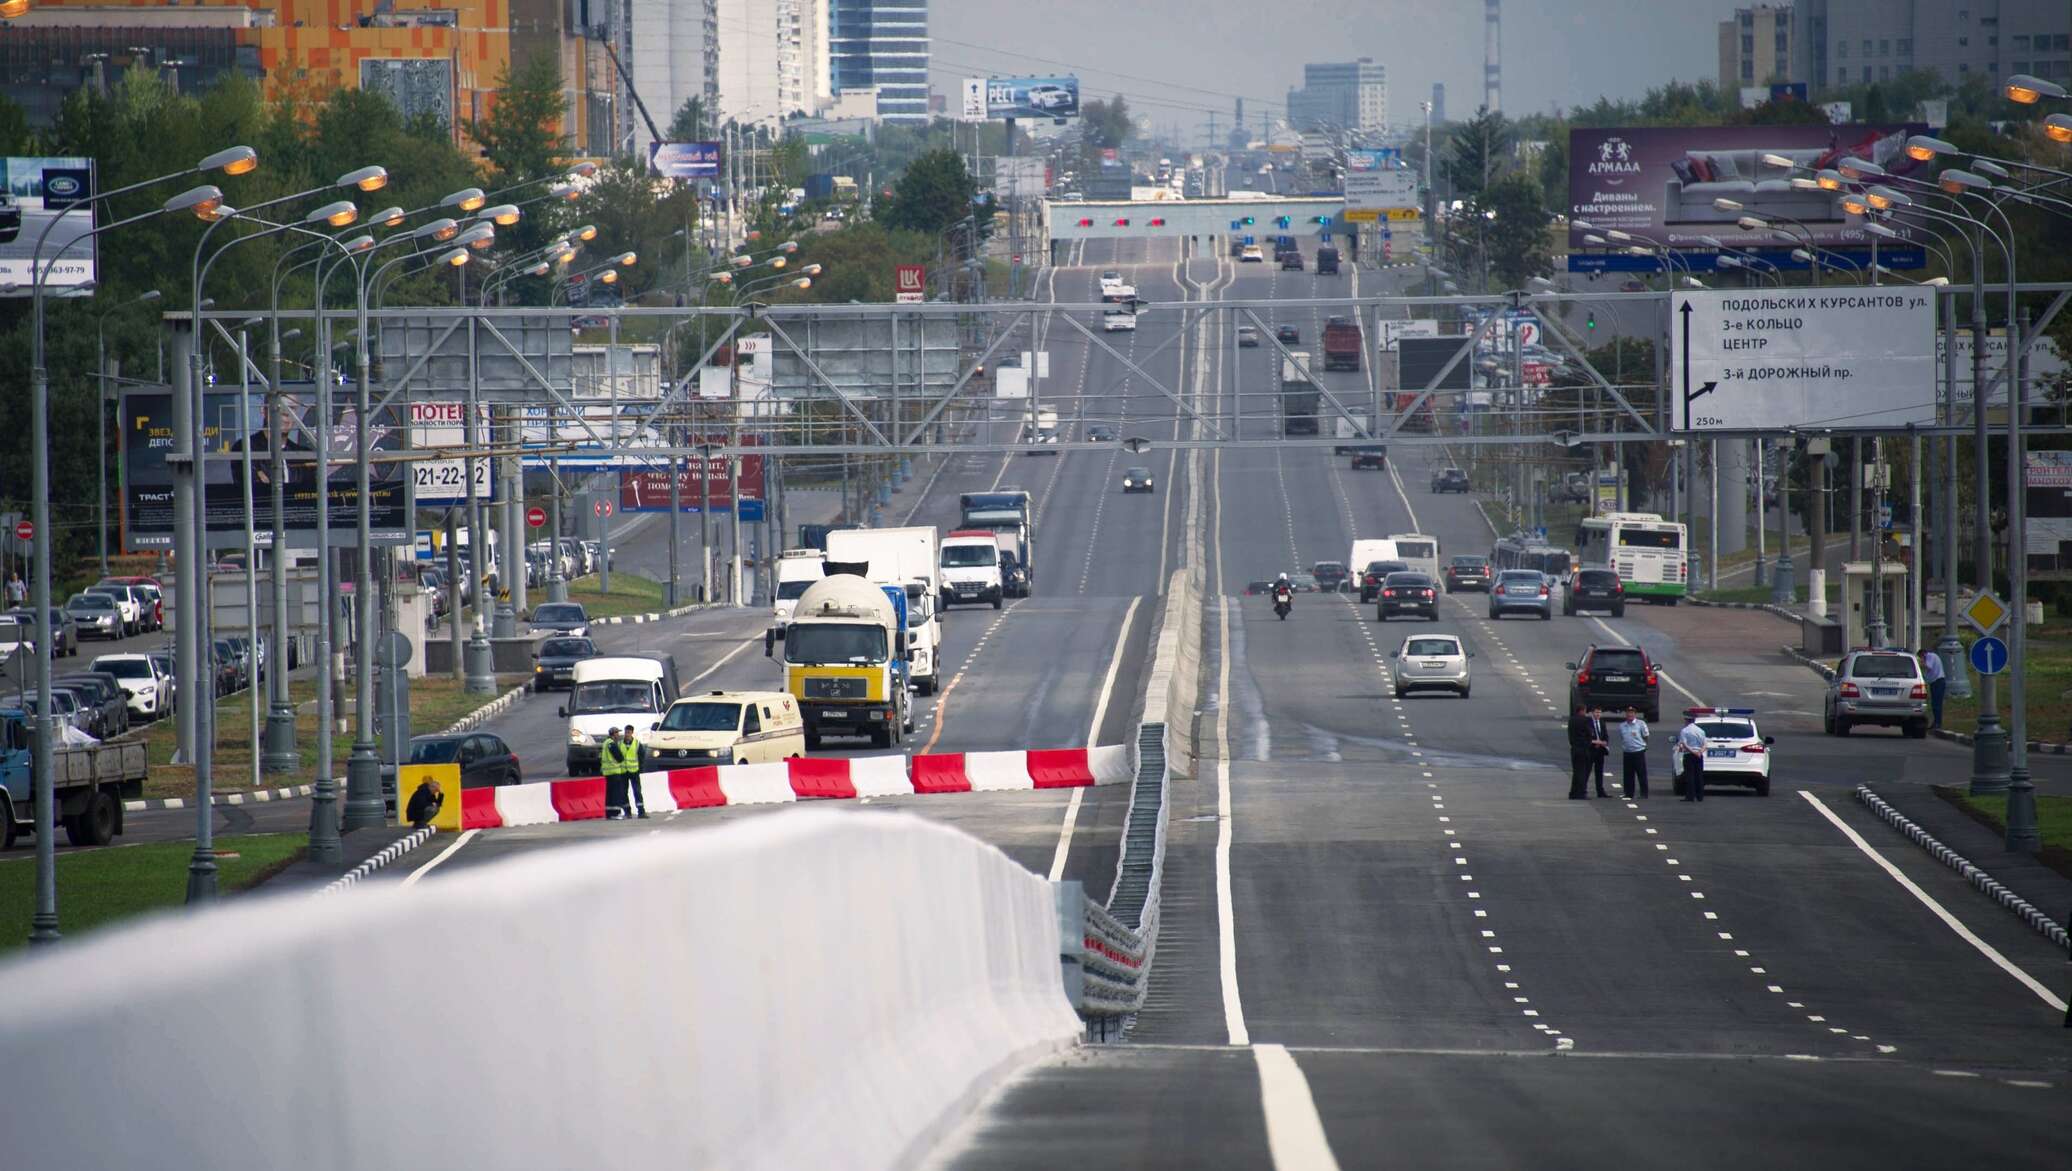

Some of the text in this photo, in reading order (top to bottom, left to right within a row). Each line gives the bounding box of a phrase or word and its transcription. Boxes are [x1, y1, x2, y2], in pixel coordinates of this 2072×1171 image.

[1588, 161, 1641, 173] АРМАДА
[1593, 192, 1638, 203] Диваны
[1581, 202, 1657, 215] настроением.
[1722, 295, 1928, 312] ПОДОЛЬСКИХ КУРСАНТОВ ул.
[1747, 318, 1803, 331] КОЛЬЦО
[1723, 338, 1768, 351] ЦЕНТР
[1723, 365, 1853, 381] 3-й ДОРОЖНЫЙ пр.
[1696, 417, 1723, 426] 250м
[139, 493, 170, 501] ТРАСТ
